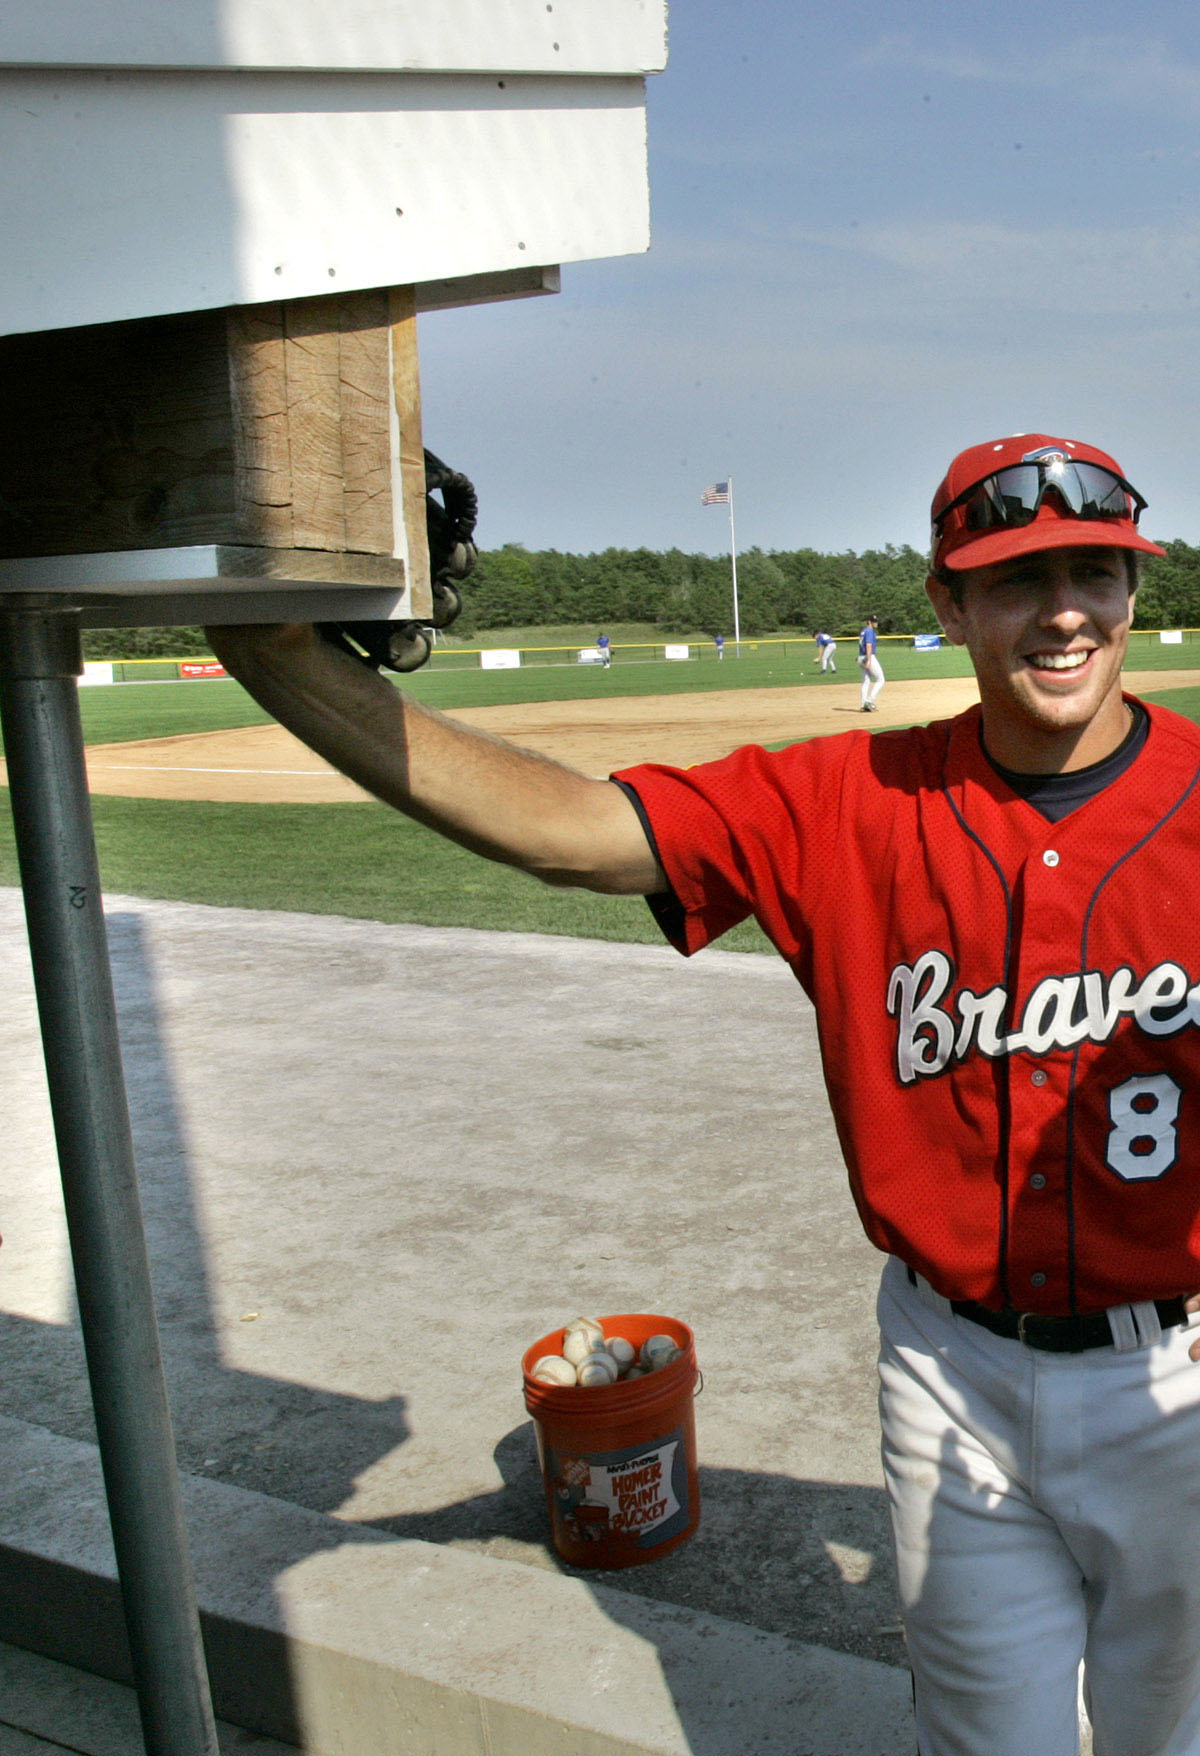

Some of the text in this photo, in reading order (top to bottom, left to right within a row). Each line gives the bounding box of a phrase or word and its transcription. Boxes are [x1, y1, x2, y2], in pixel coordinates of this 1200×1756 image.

[1105, 1072, 1182, 1183] 8
[611, 1461, 662, 1497] HOMER
[611, 1498, 668, 1530] BUCKET
[618, 1482, 661, 1513] PAINT
